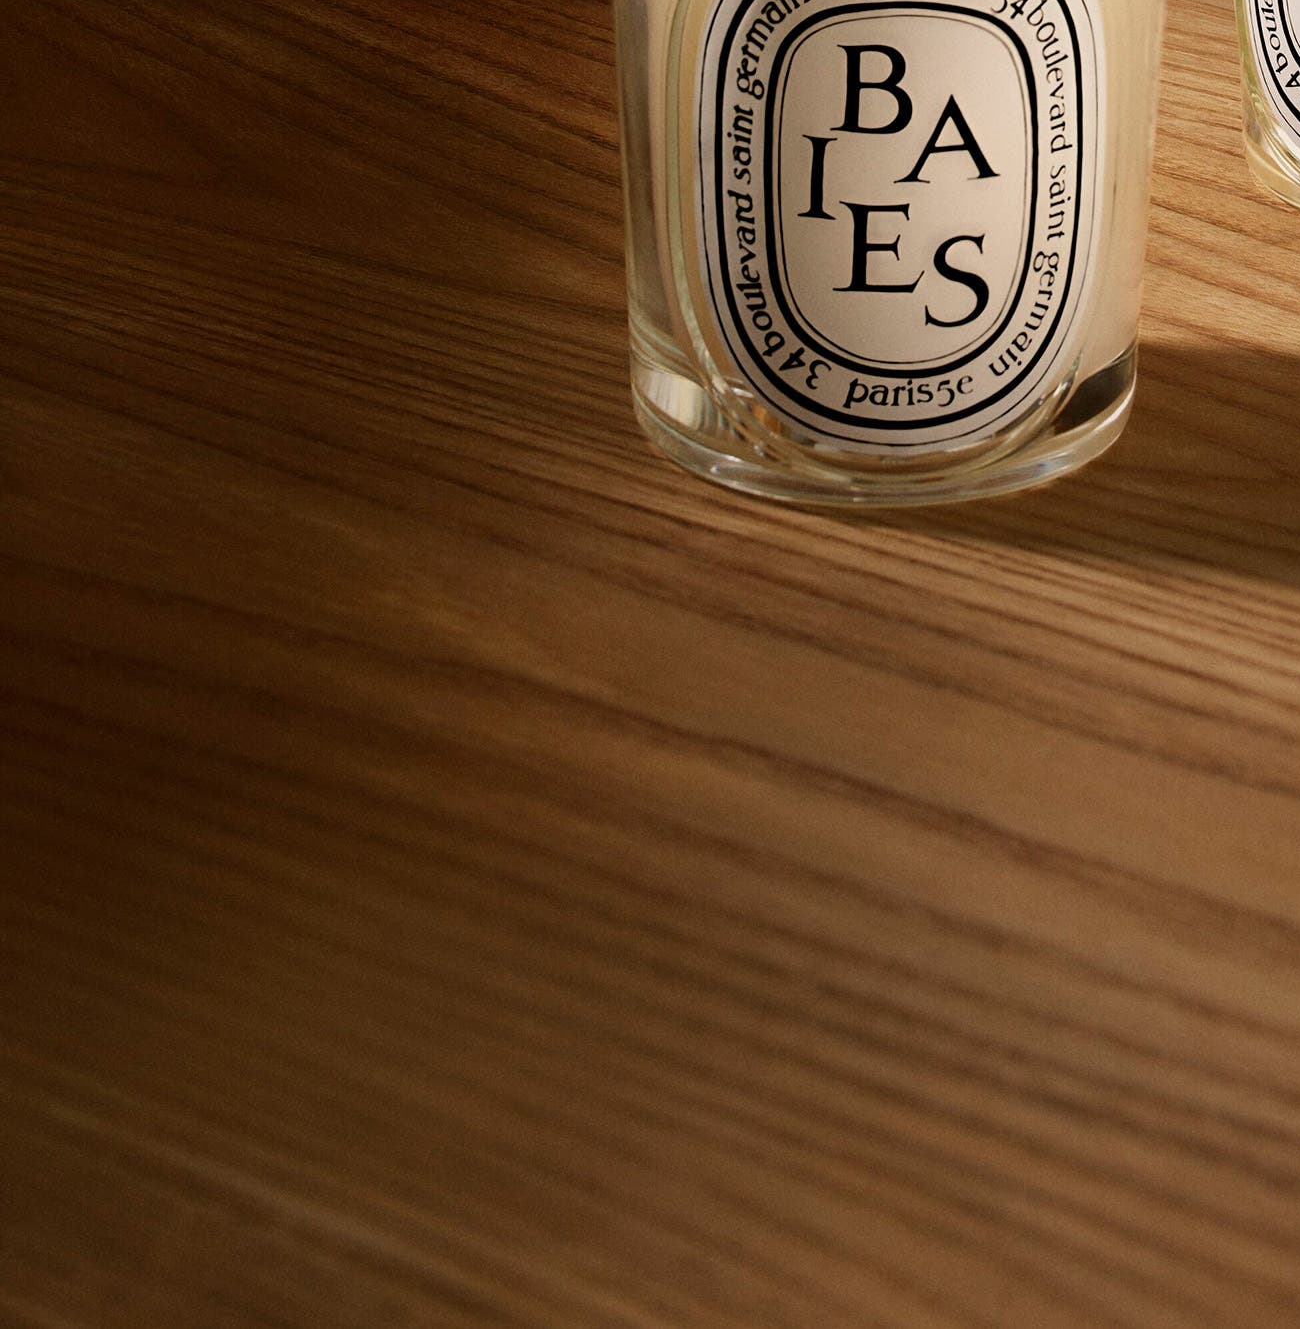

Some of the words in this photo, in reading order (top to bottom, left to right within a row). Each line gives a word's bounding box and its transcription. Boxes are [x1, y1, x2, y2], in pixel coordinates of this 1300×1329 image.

[729, 106, 755, 185] saint
[1049, 164, 1072, 242] saint
[988, 250, 1061, 379] germain
